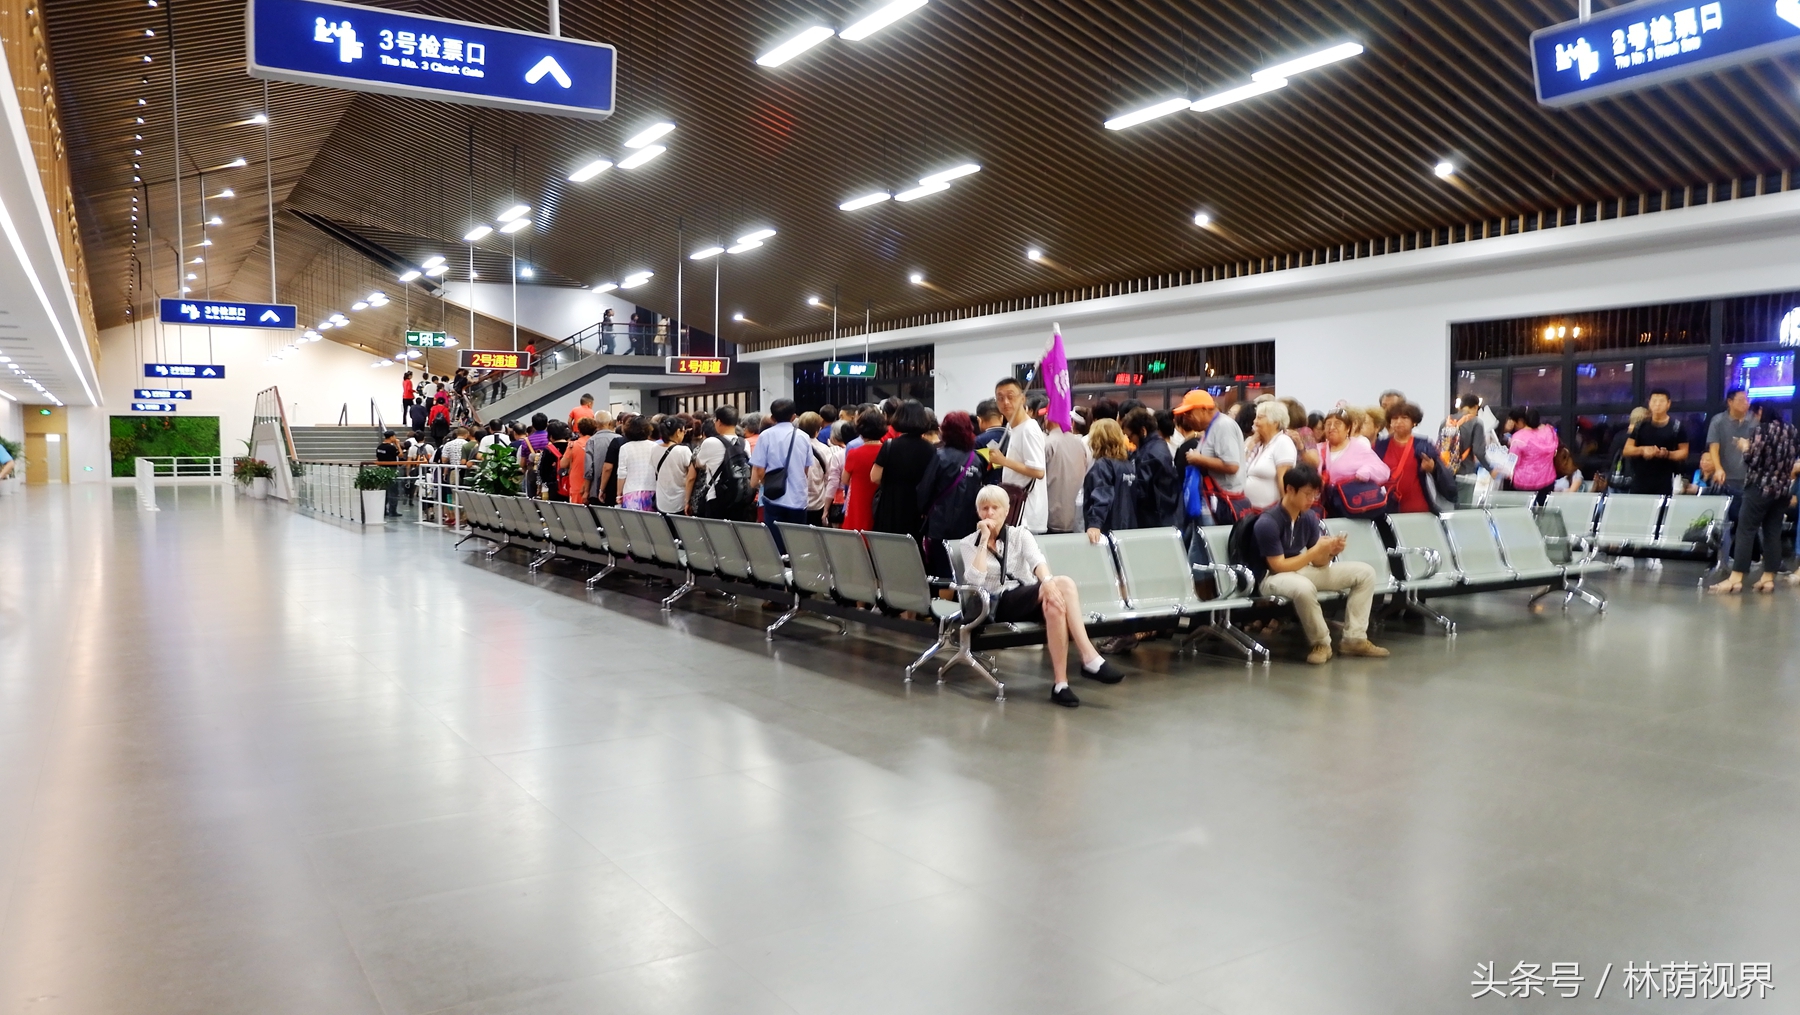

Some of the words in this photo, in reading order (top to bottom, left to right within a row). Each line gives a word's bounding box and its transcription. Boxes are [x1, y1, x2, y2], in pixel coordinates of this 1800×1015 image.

[379, 29, 485, 65] 3号检票口
[380, 54, 400, 66] The
[421, 61, 429, 70] 3
[472, 353, 518, 368] 2号通道
[680, 360, 721, 374] 1号通道
